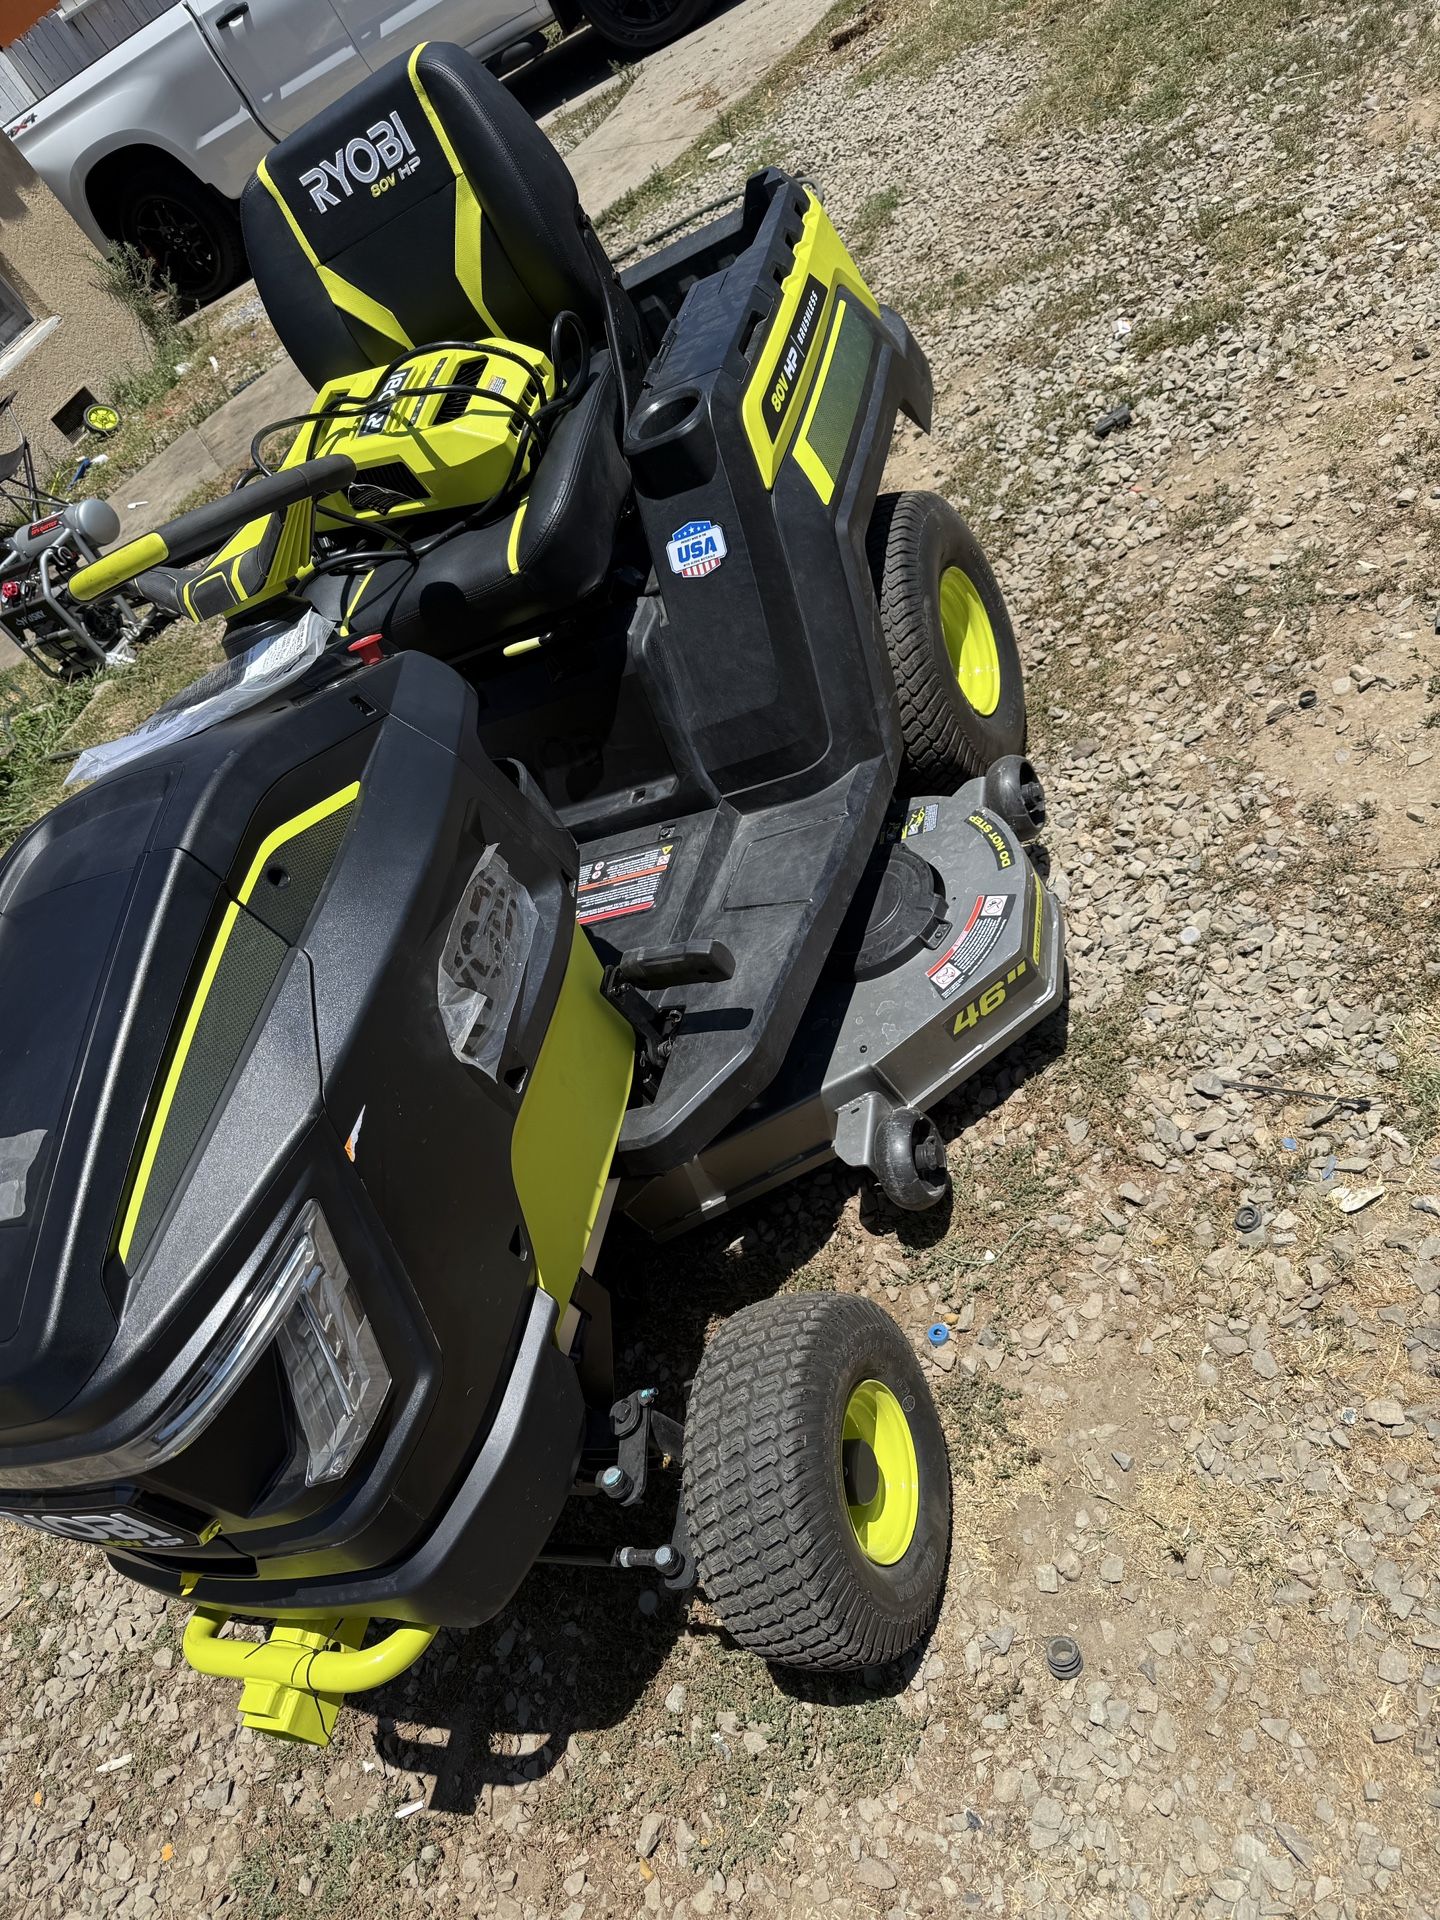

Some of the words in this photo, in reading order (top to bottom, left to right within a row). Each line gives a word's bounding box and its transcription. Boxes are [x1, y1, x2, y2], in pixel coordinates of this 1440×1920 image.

[299, 110, 417, 215] RYOBI
[370, 172, 396, 198] 80V
[397, 156, 421, 181] HP
[771, 372, 789, 413] 80V
[783, 346, 798, 381] HP
[796, 290, 818, 345] BRUSHLESS
[677, 535, 718, 564] USA
[968, 815, 992, 834] STEP
[988, 832, 1006, 852] NOT
[999, 850, 1012, 868] DO
